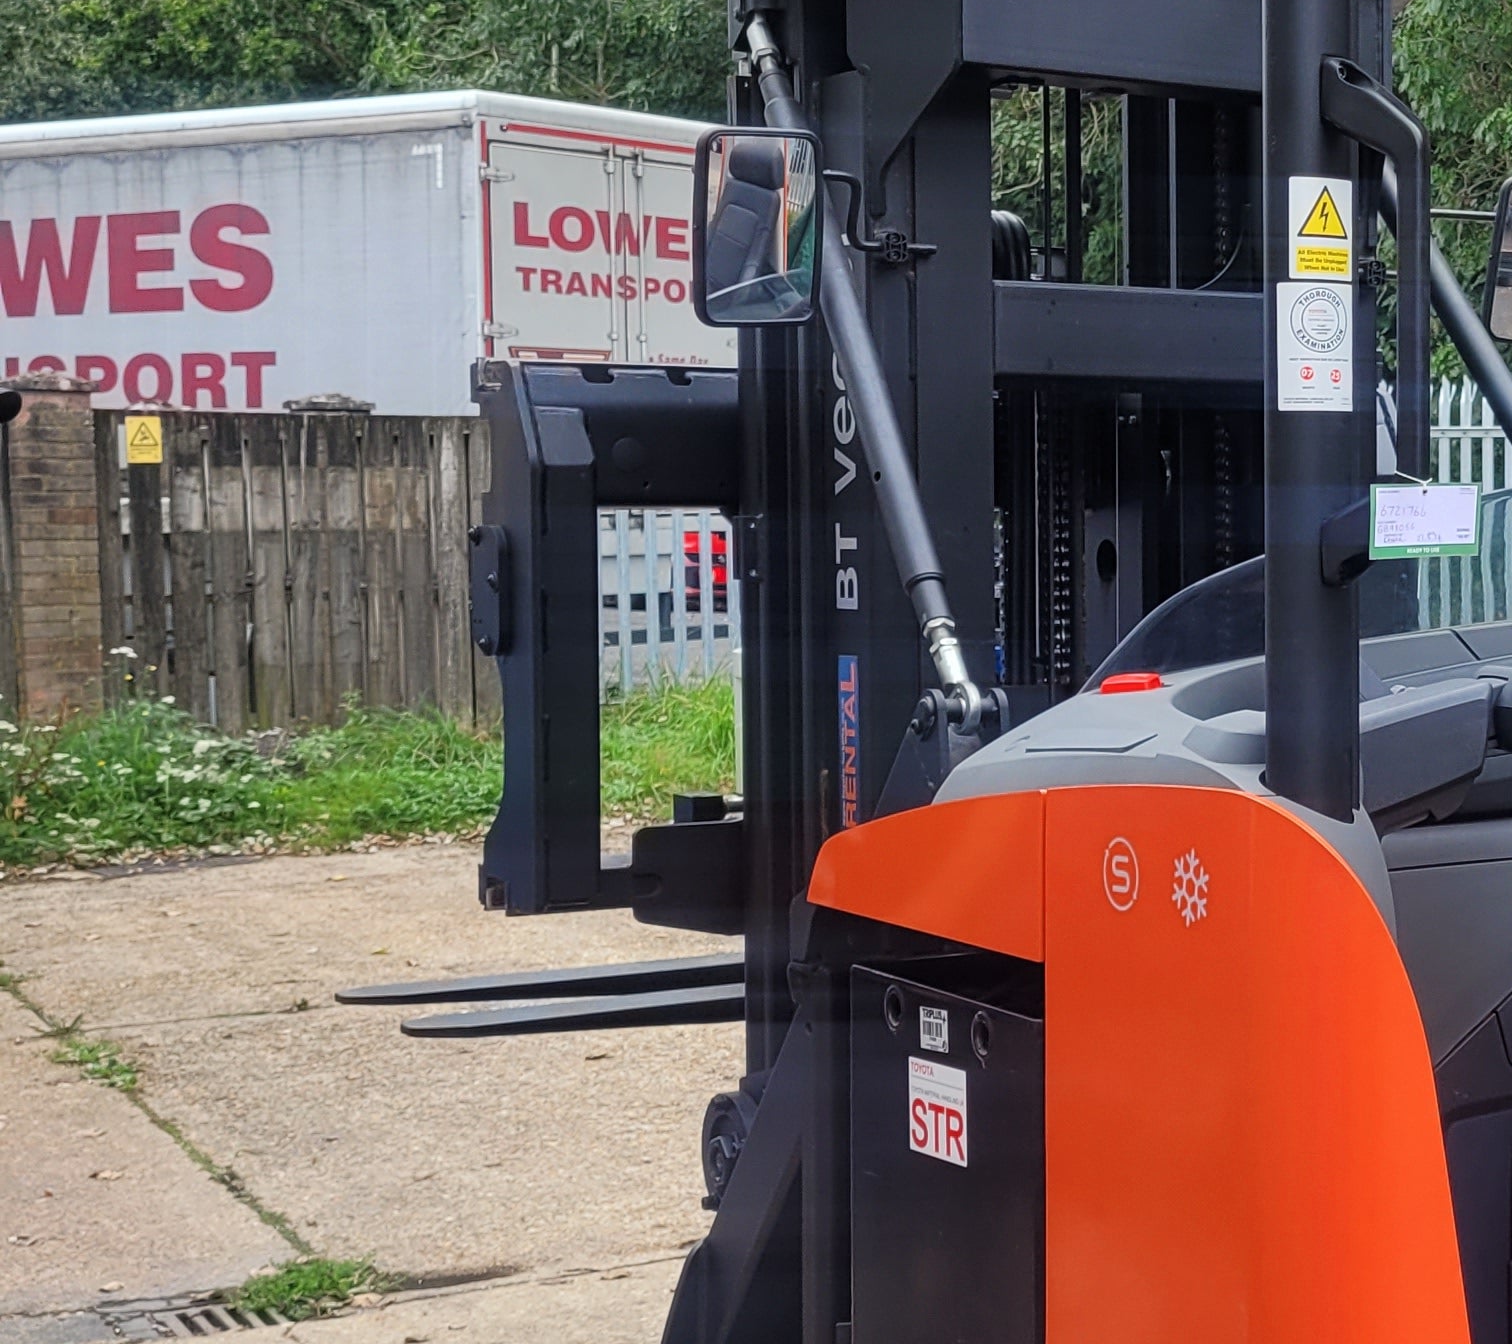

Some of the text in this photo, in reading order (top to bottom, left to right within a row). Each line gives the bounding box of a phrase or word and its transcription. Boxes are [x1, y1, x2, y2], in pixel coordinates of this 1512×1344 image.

[515, 266, 695, 305] TRANSPO
[1298, 291, 1341, 308] THOROUGH
[1296, 329, 1344, 350] EXAMINATION
[1301, 368, 1313, 378] 07
[834, 522, 859, 612] BT
[839, 663, 857, 828] RENTAL
[910, 1061, 934, 1077] TOYOTA
[911, 1097, 965, 1162] STR
